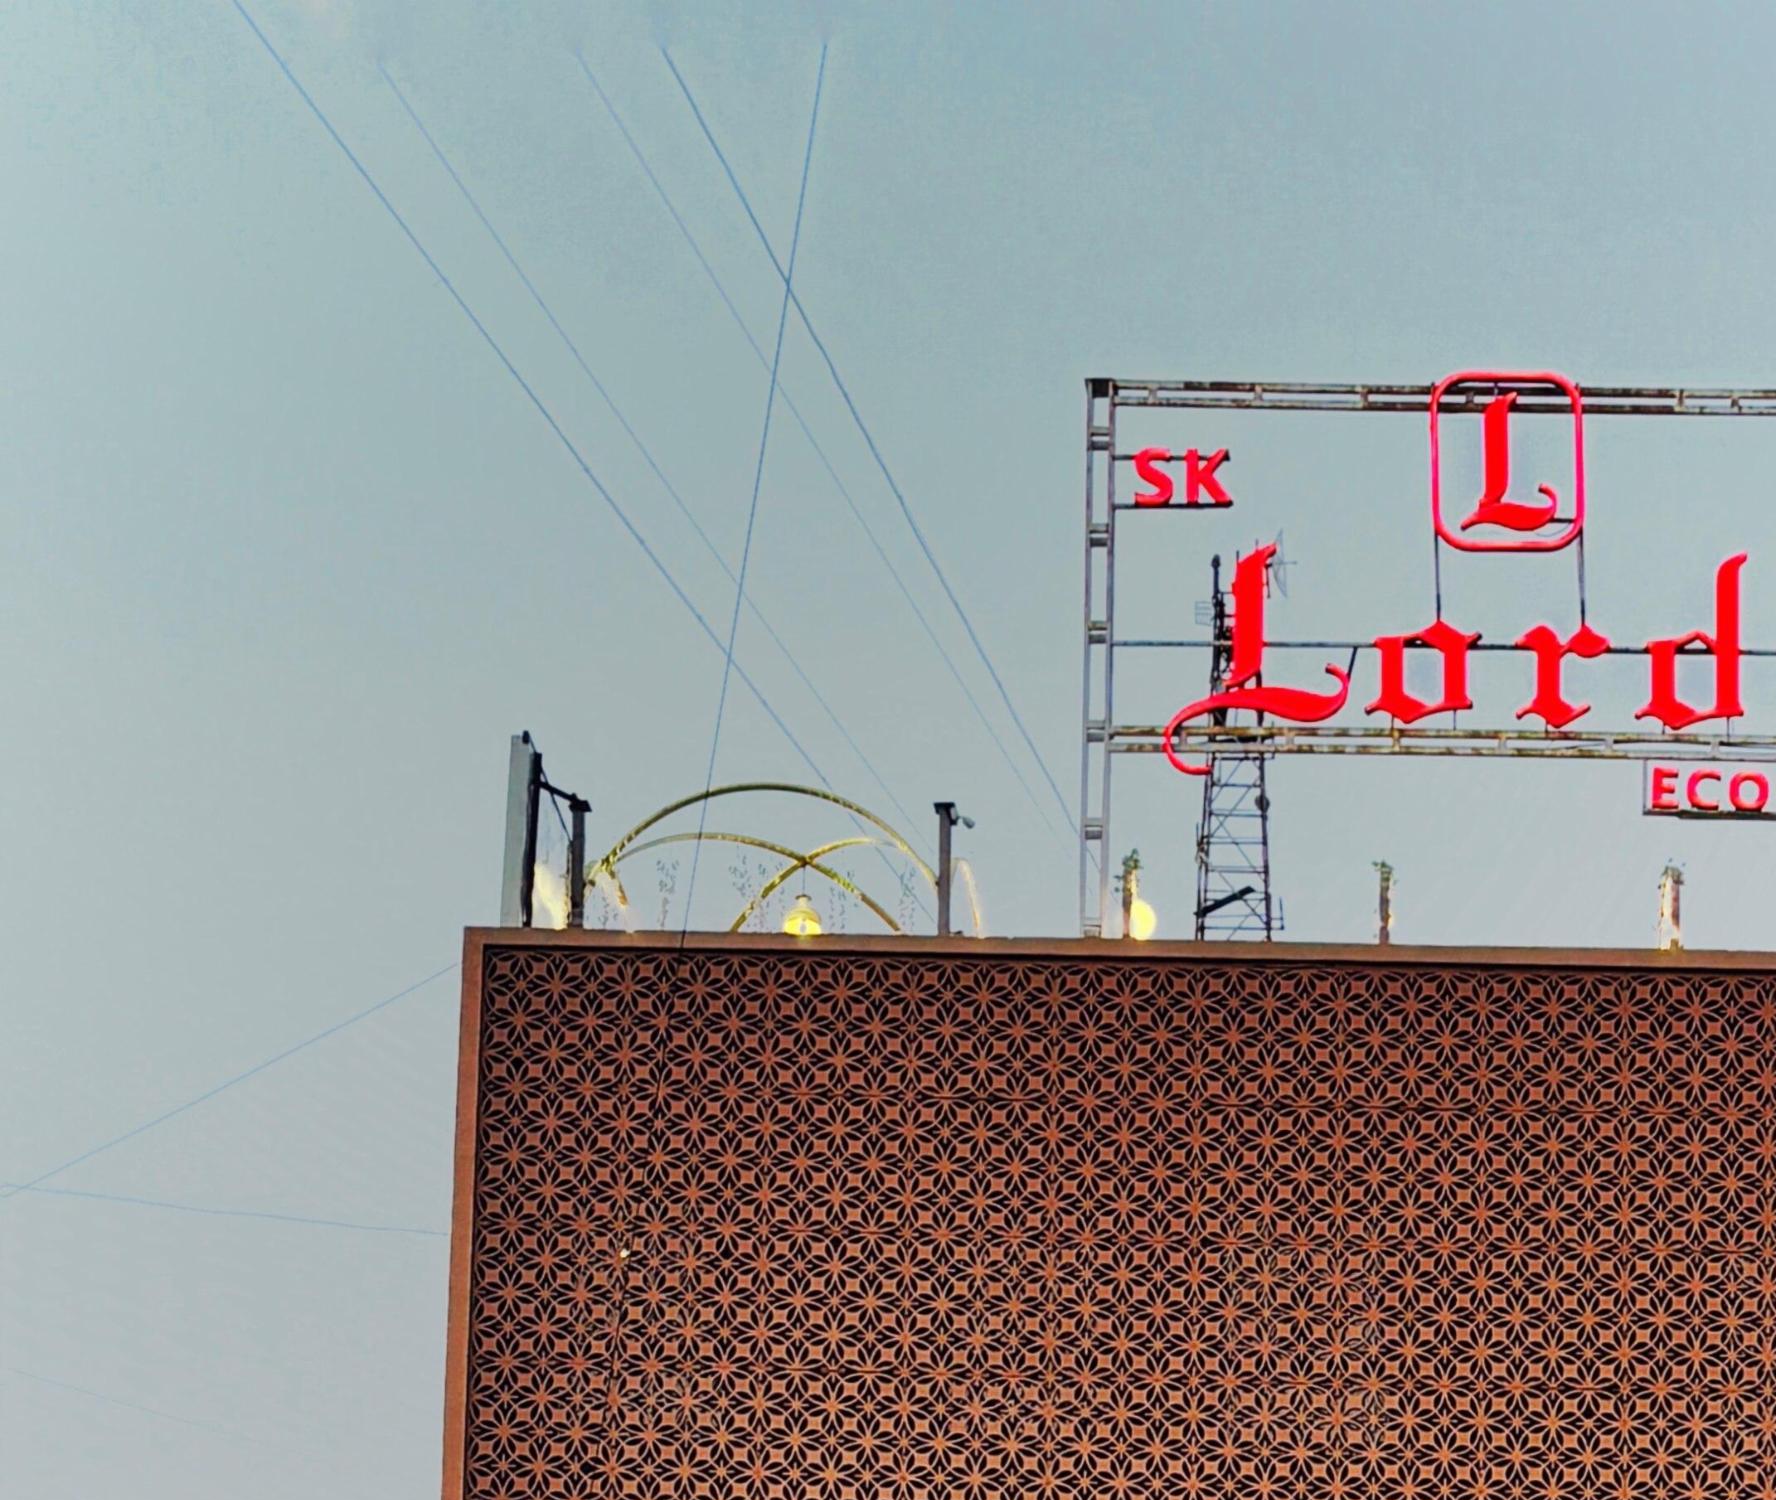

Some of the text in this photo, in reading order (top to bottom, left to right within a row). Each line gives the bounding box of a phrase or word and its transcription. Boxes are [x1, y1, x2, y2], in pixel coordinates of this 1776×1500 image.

[1133, 447, 1234, 507] SK
[1460, 390, 1557, 532] L
[1650, 766, 1770, 813] ECO
